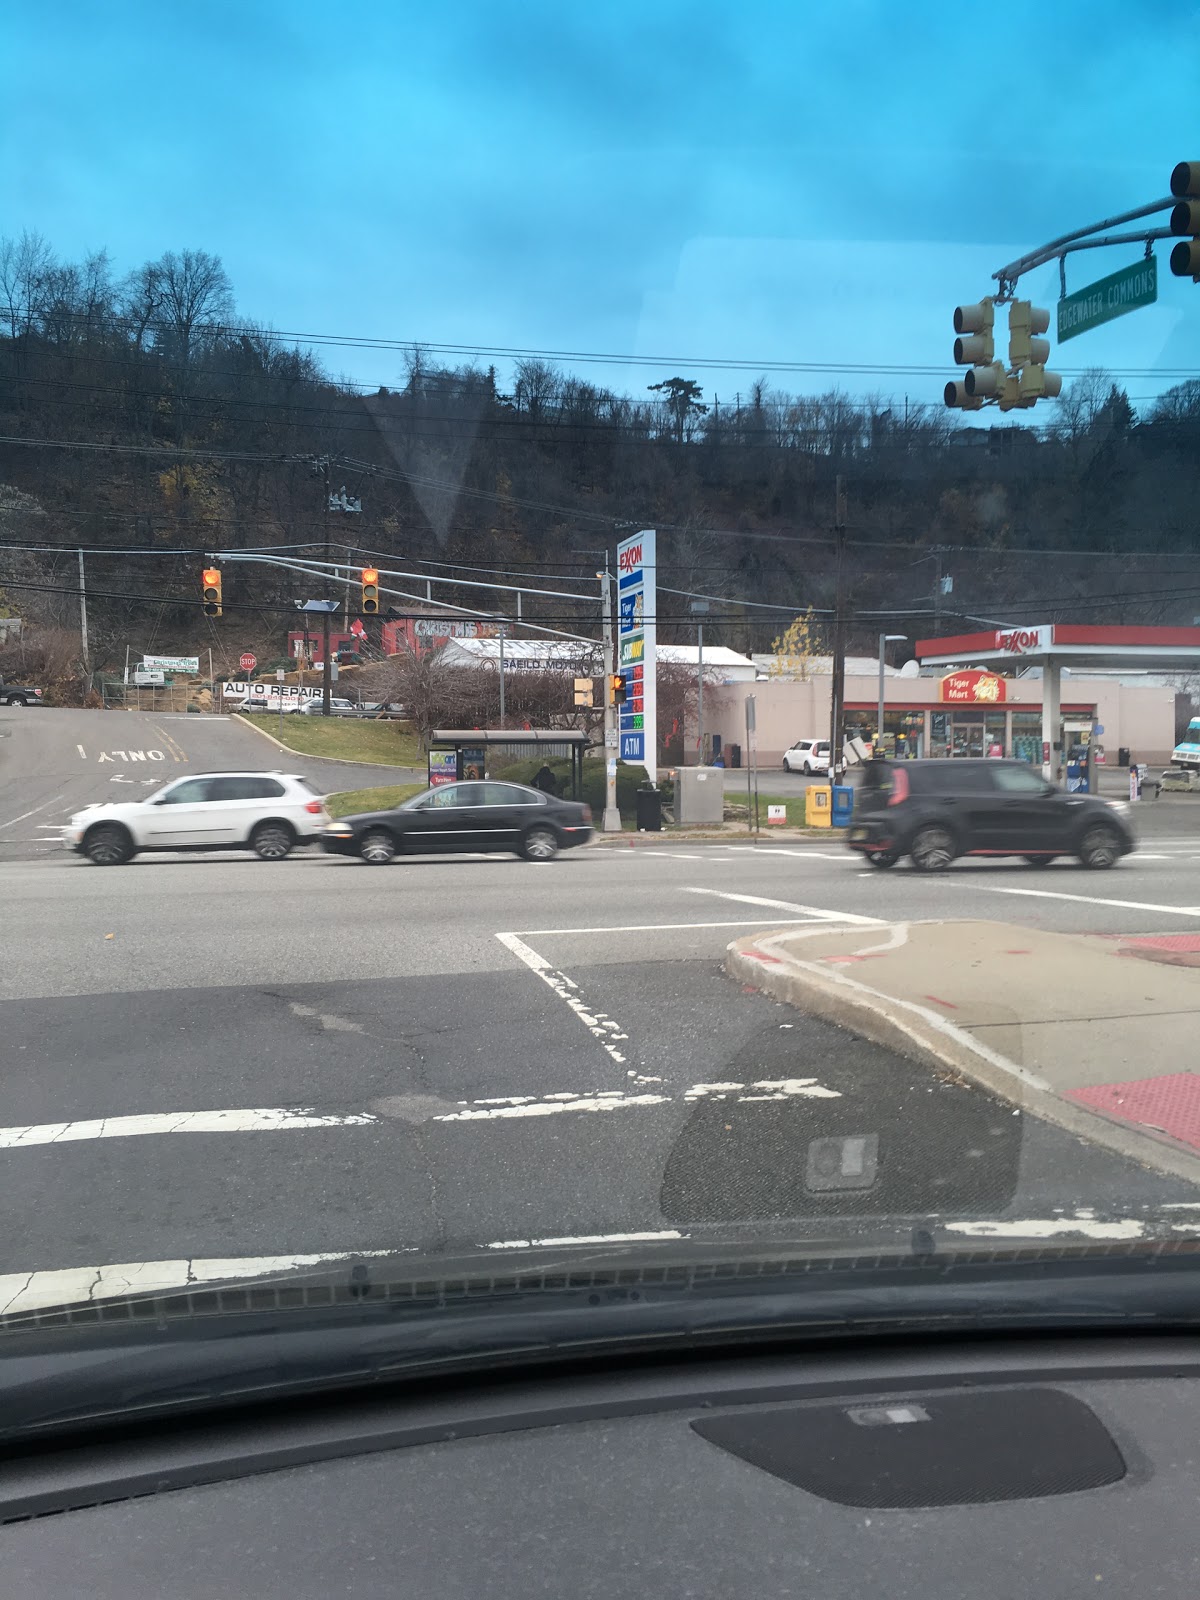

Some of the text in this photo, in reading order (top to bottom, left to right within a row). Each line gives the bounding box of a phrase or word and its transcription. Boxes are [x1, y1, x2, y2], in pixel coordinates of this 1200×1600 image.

[1060, 268, 1155, 332] EDGEWATER COMMONS
[620, 543, 642, 573] EXXON
[622, 602, 632, 615] Tiger
[1000, 630, 1039, 654] EXXON
[622, 640, 644, 661] SUBWAY
[241, 658, 256, 666] STOP
[224, 683, 326, 698] AUTO REPAIR
[948, 678, 970, 690] Tiger
[948, 690, 969, 700] Mart
[624, 737, 640, 755] ATM
[98, 750, 166, 762] ONLY
